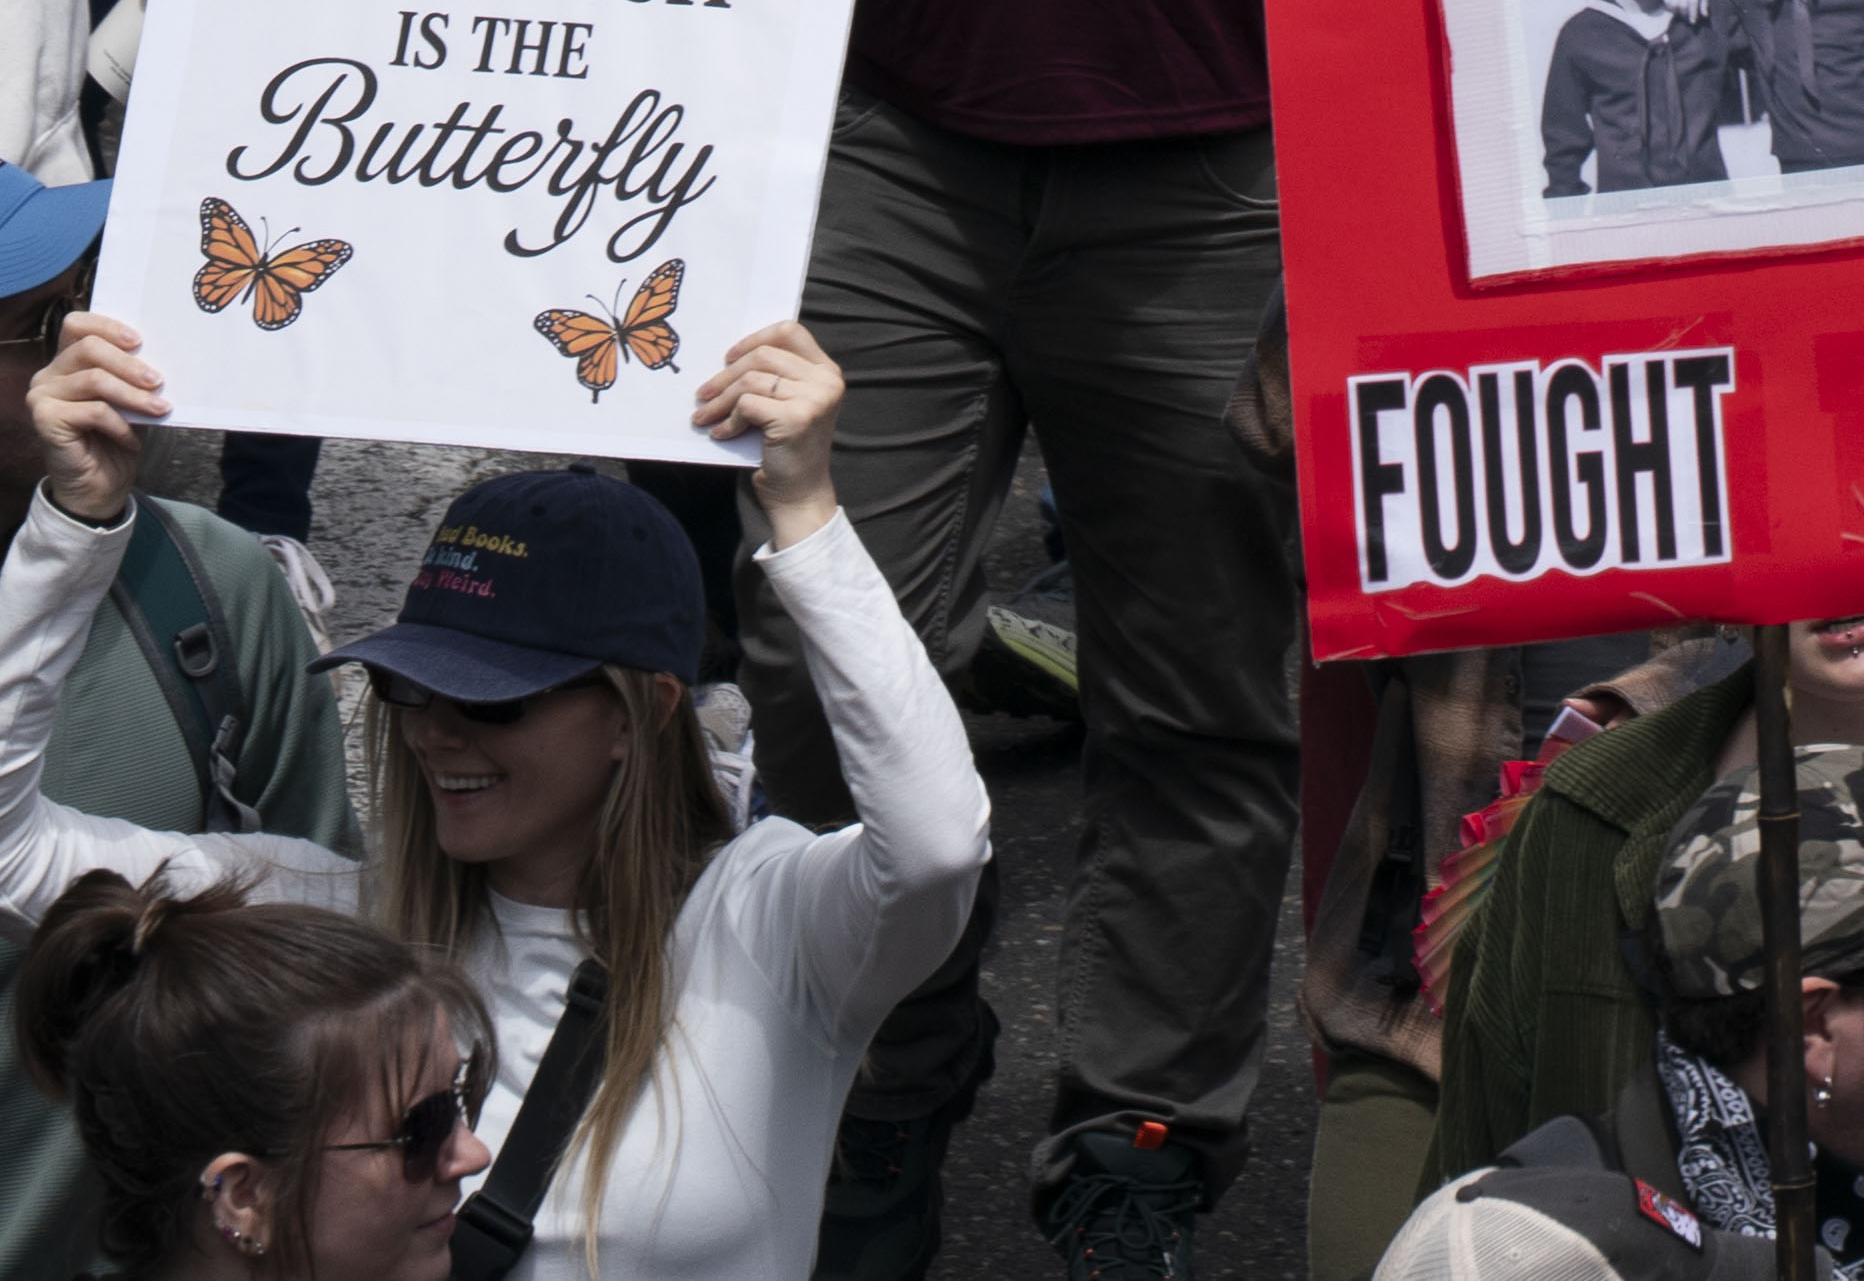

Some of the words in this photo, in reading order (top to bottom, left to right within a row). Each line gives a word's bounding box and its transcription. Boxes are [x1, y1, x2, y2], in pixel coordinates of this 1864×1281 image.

[388, 11, 448, 71] IS
[472, 16, 594, 81] THE
[226, 56, 717, 263] Butterfly
[1353, 351, 1731, 585] FOUGHT
[461, 526, 529, 557] Books.
[436, 570, 496, 598] Weird.
